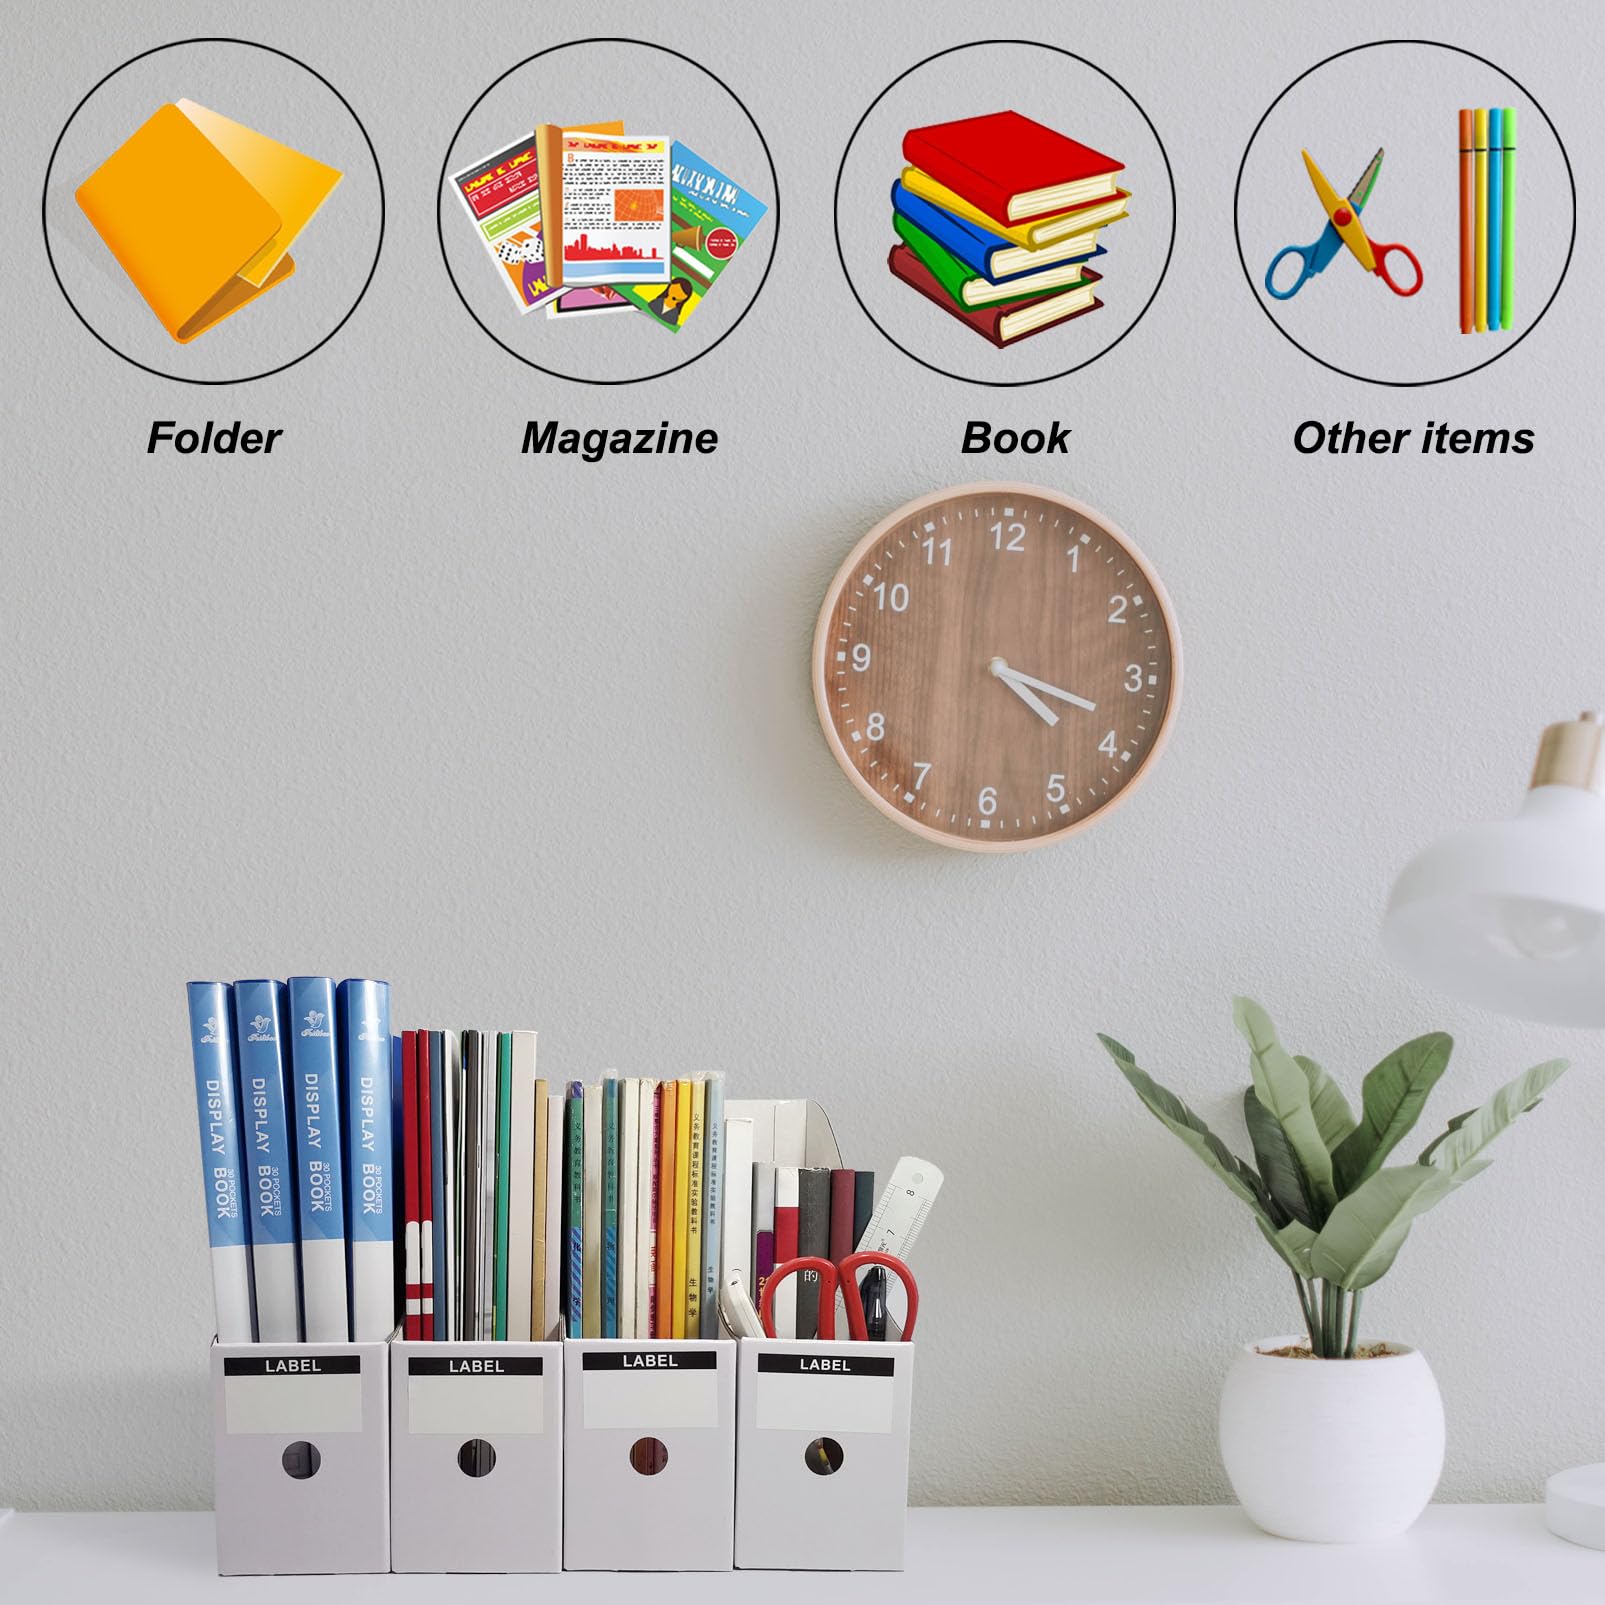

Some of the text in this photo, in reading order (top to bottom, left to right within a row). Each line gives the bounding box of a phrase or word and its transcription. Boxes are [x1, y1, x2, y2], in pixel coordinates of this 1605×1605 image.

[990, 521, 1026, 552] 12
[922, 537, 952, 566] 11
[1067, 545, 1080, 573] 1
[873, 582, 909, 612] 10
[1108, 596, 1128, 624] 2
[852, 643, 872, 672] 9
[1124, 664, 1143, 692] 3
[866, 713, 885, 742] 8
[1098, 730, 1117, 758] 4
[913, 763, 932, 790] 7
[1046, 774, 1065, 802] 5
[978, 787, 997, 815] 6
[206, 1080, 231, 1219] DISPLAY BOOK
[252, 1078, 274, 1217] DISPLAY BOOK
[305, 1073, 325, 1212] DISPLAY BOOK
[360, 1077, 376, 1214] DISPLAY BOOK
[228, 1180, 239, 1218] POCKETS
[272, 1178, 282, 1216] POCKETS
[323, 1174, 332, 1212] POCKETS
[375, 1177, 383, 1214] POCKETS
[905, 1188, 915, 1197] 8
[886, 1228, 896, 1237] 7
[804, 1270, 818, 1283] 的
[689, 1278, 698, 1317] 生物学
[266, 1359, 322, 1373] LABEL
[449, 1360, 505, 1373] LABEL
[623, 1354, 678, 1368] LABEL
[800, 1359, 851, 1372] LABEL
